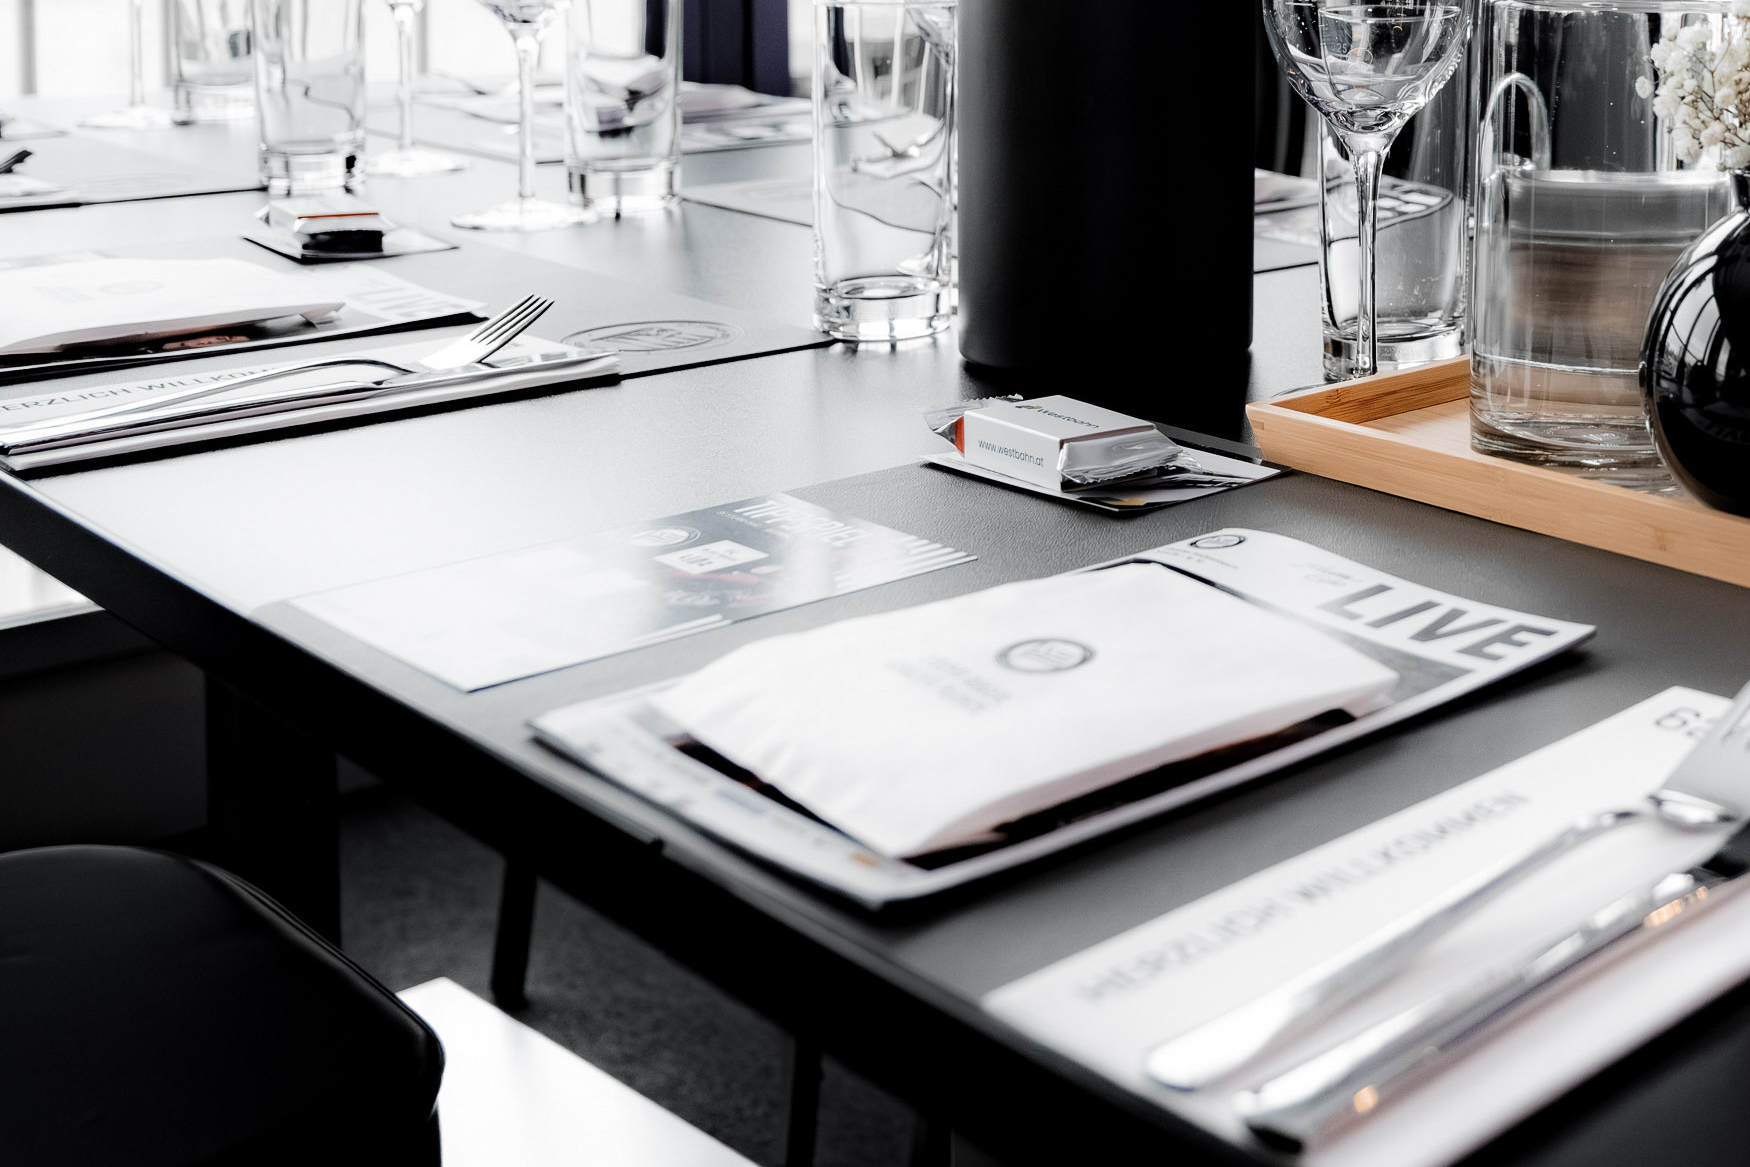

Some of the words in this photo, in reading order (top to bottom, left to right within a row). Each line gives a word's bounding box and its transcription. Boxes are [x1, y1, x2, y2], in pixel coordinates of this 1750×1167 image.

[0, 388, 132, 411] ERZLICH
[1037, 408, 1099, 429] Westbahn
[978, 439, 1044, 467] www.westbahn.at
[1319, 583, 1560, 662] LIVE
[1075, 897, 1287, 1003] HERZLICH
[1294, 789, 1531, 904] WILLKOMMEN
